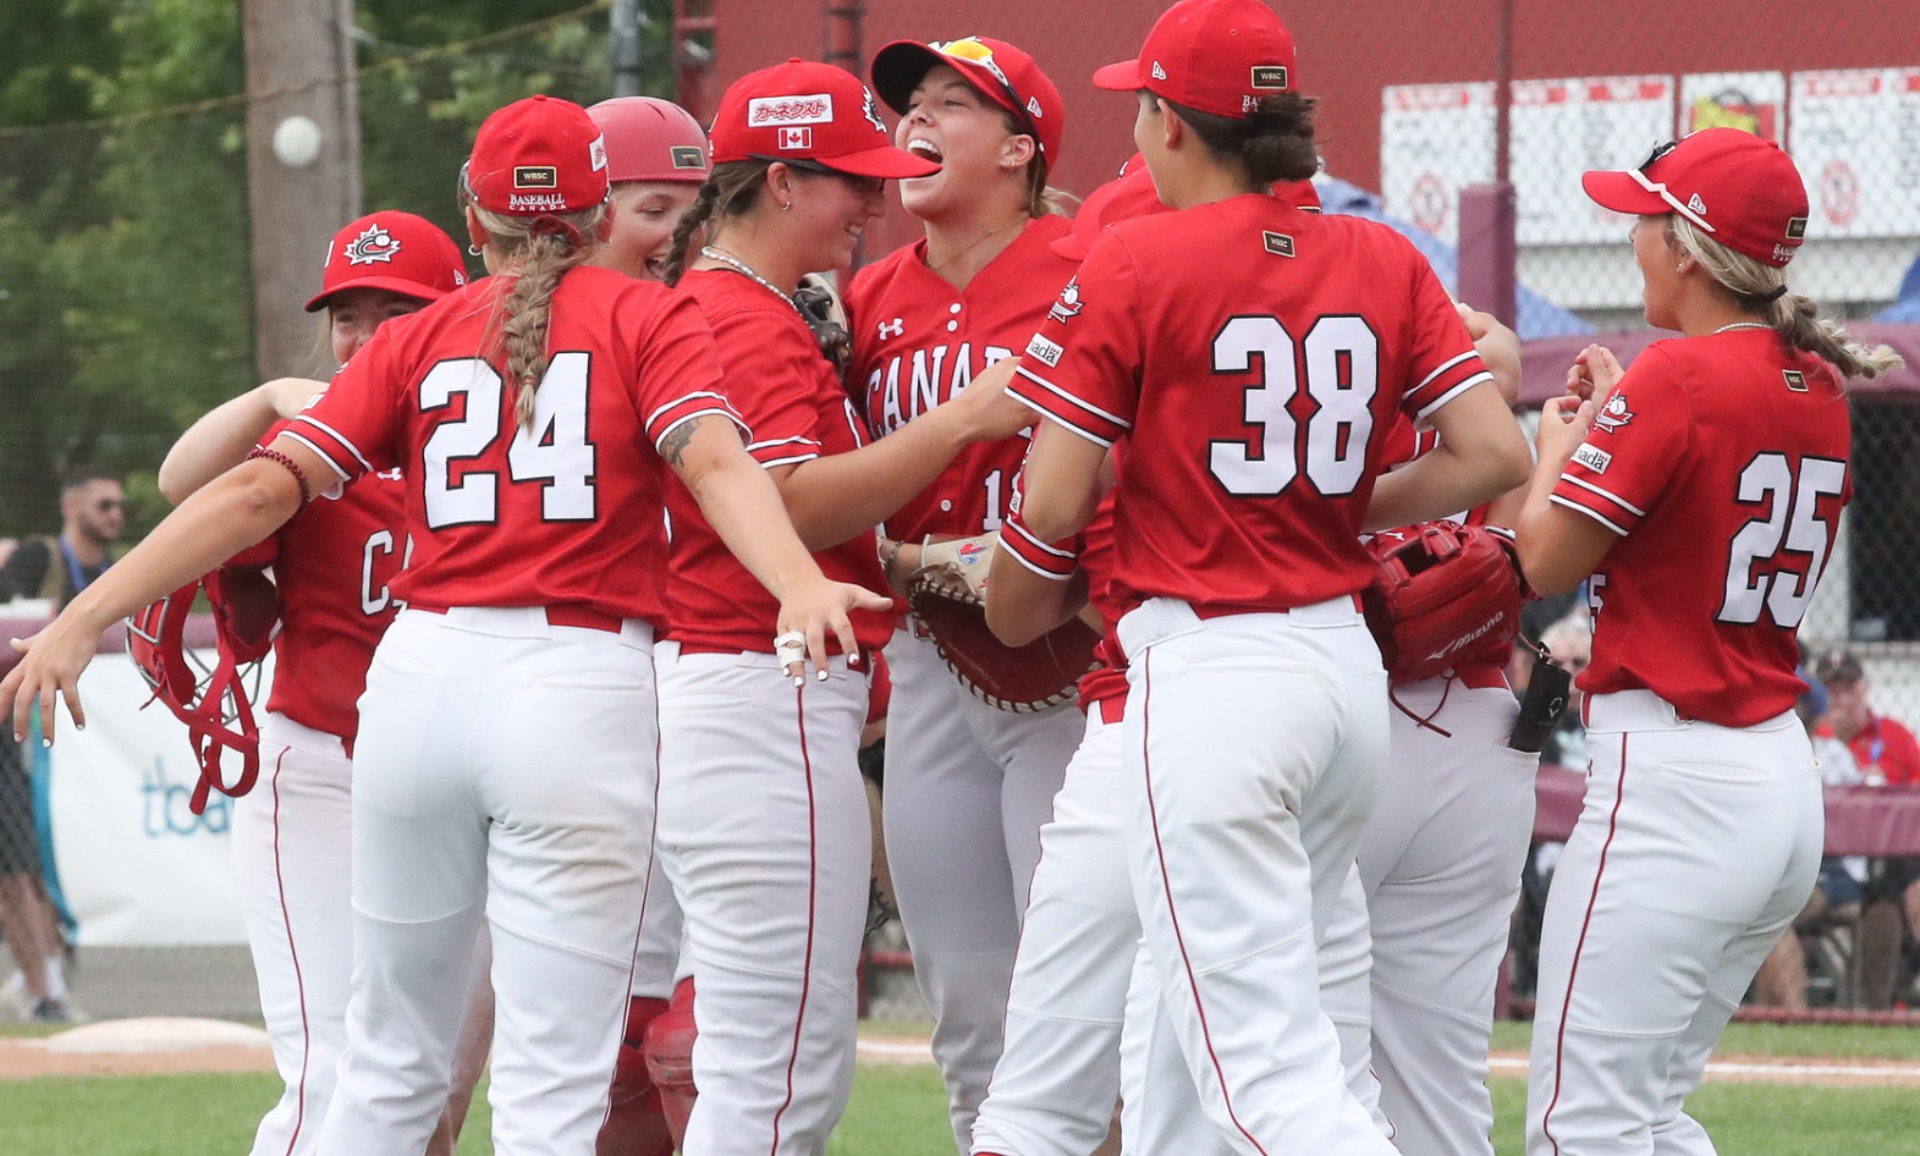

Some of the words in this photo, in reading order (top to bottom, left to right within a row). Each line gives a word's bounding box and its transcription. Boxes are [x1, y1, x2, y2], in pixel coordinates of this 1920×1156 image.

[753, 99, 827, 122] カーネクスト
[508, 192, 565, 206] BASEBALL
[523, 172, 548, 180] WBSC
[508, 203, 566, 212] CANADA
[866, 342, 1032, 441] CANA
[1207, 313, 1379, 498] 38
[418, 351, 598, 532] 24
[1712, 451, 1847, 629] 25
